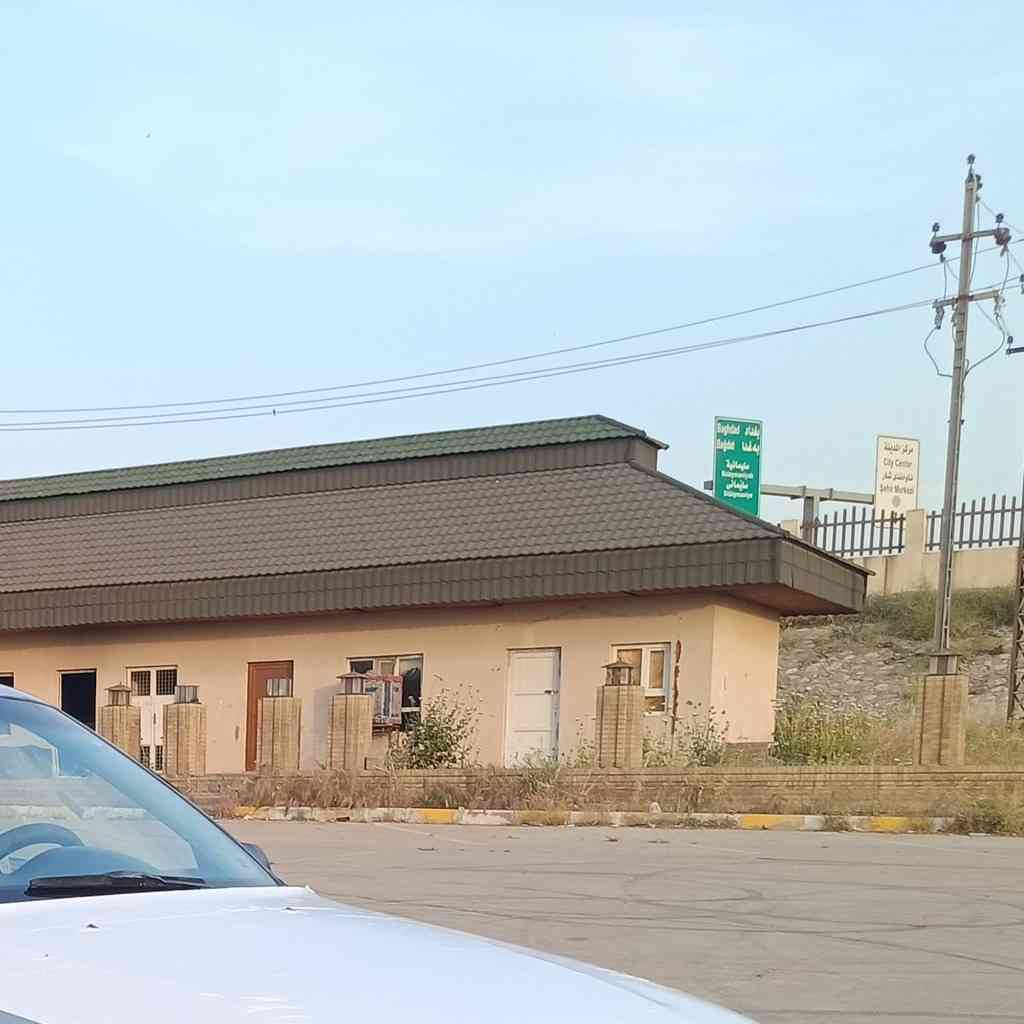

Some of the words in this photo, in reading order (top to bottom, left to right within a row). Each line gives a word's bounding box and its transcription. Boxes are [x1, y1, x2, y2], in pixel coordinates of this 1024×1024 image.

[718, 423, 740, 436] Baghdad
[883, 457, 894, 469] City
[895, 459, 912, 468] Center
